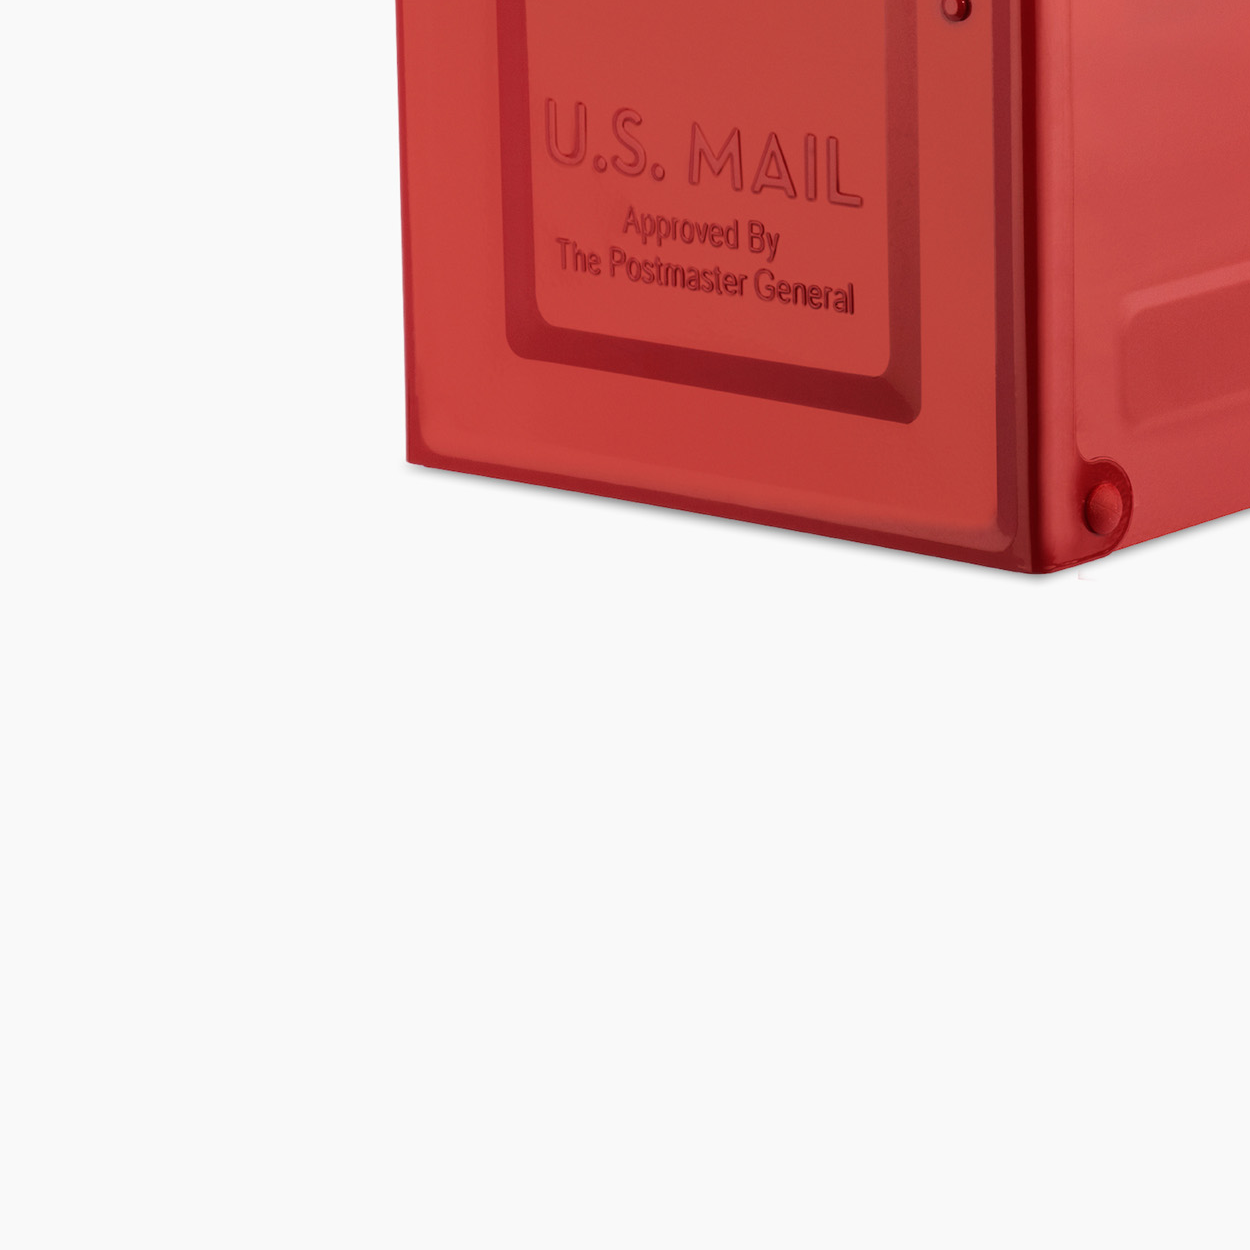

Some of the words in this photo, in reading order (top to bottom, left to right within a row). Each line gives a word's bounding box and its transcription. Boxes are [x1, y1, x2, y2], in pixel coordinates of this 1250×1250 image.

[545, 97, 665, 181] U.S.
[688, 121, 863, 207] MAIL
[623, 205, 739, 249] Approved
[747, 219, 780, 262] By
[556, 237, 601, 275] The
[609, 246, 748, 296] Postmaster
[754, 268, 855, 315] General
